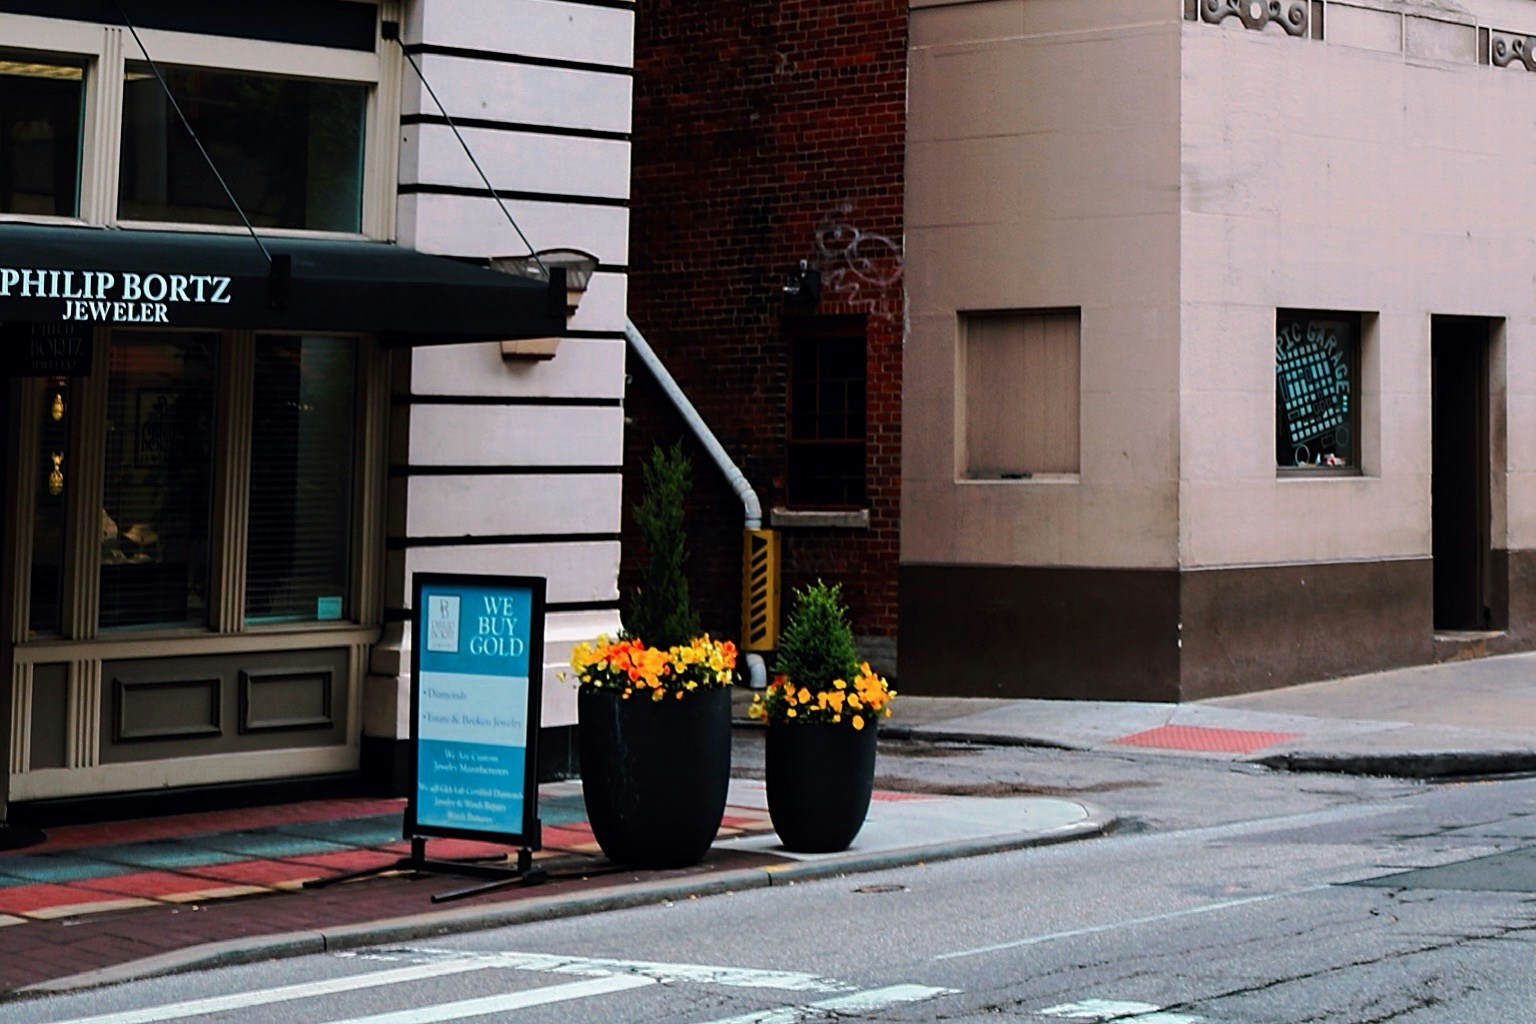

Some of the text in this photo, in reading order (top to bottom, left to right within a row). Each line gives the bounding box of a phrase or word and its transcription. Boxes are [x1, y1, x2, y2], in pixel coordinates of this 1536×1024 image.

[0, 268, 232, 304] PHILIP BORTZ
[62, 300, 169, 323] JEWELER
[483, 595, 514, 617] WE
[478, 616, 518, 636] BUY
[469, 636, 524, 657] GOLD
[428, 687, 467, 700] Diamonds
[451, 715, 459, 724] &
[462, 715, 492, 727] Broken
[493, 717, 522, 729] Jewelry
[471, 752, 499, 763] Custom
